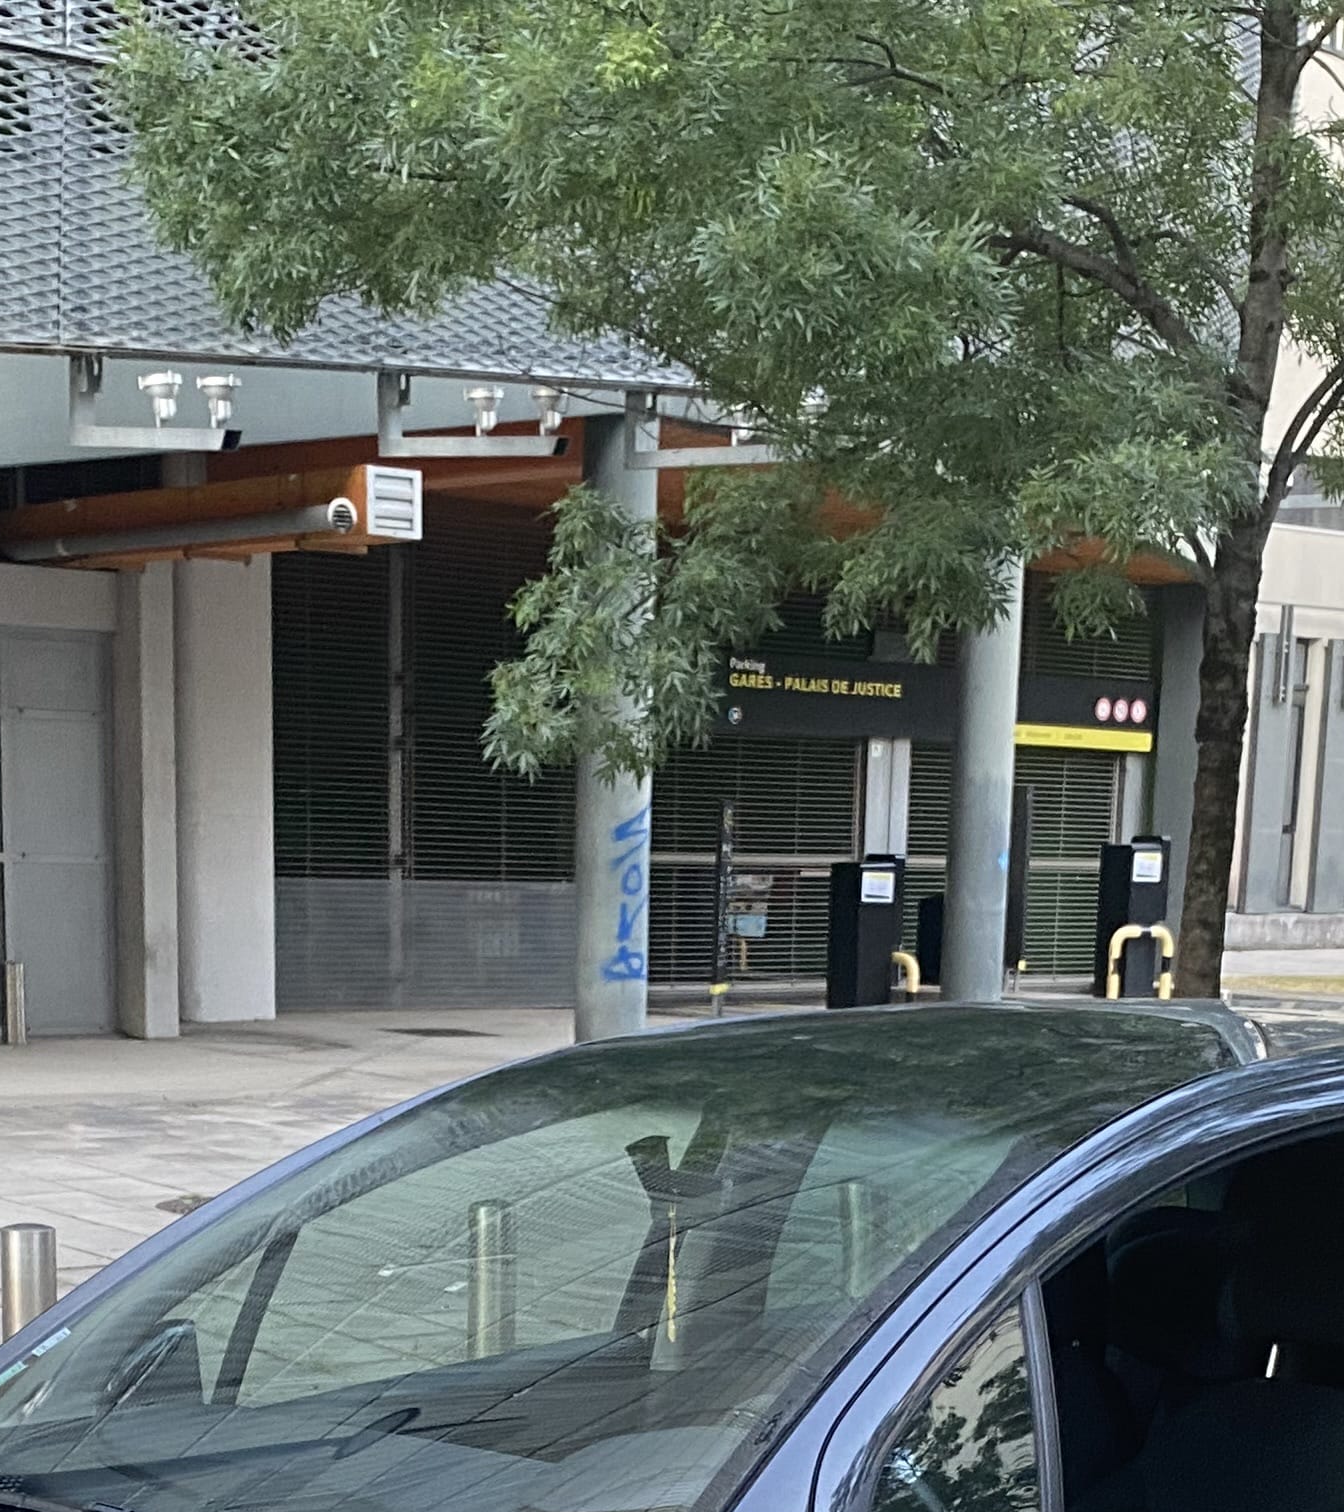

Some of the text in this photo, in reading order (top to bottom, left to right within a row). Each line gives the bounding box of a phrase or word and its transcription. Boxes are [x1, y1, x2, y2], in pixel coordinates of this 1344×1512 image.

[729, 657, 766, 674] Parking
[729, 673, 774, 689] GARES
[784, 676, 830, 693] PALAIS
[831, 681, 850, 694] DE
[851, 682, 903, 698] JUSTICE
